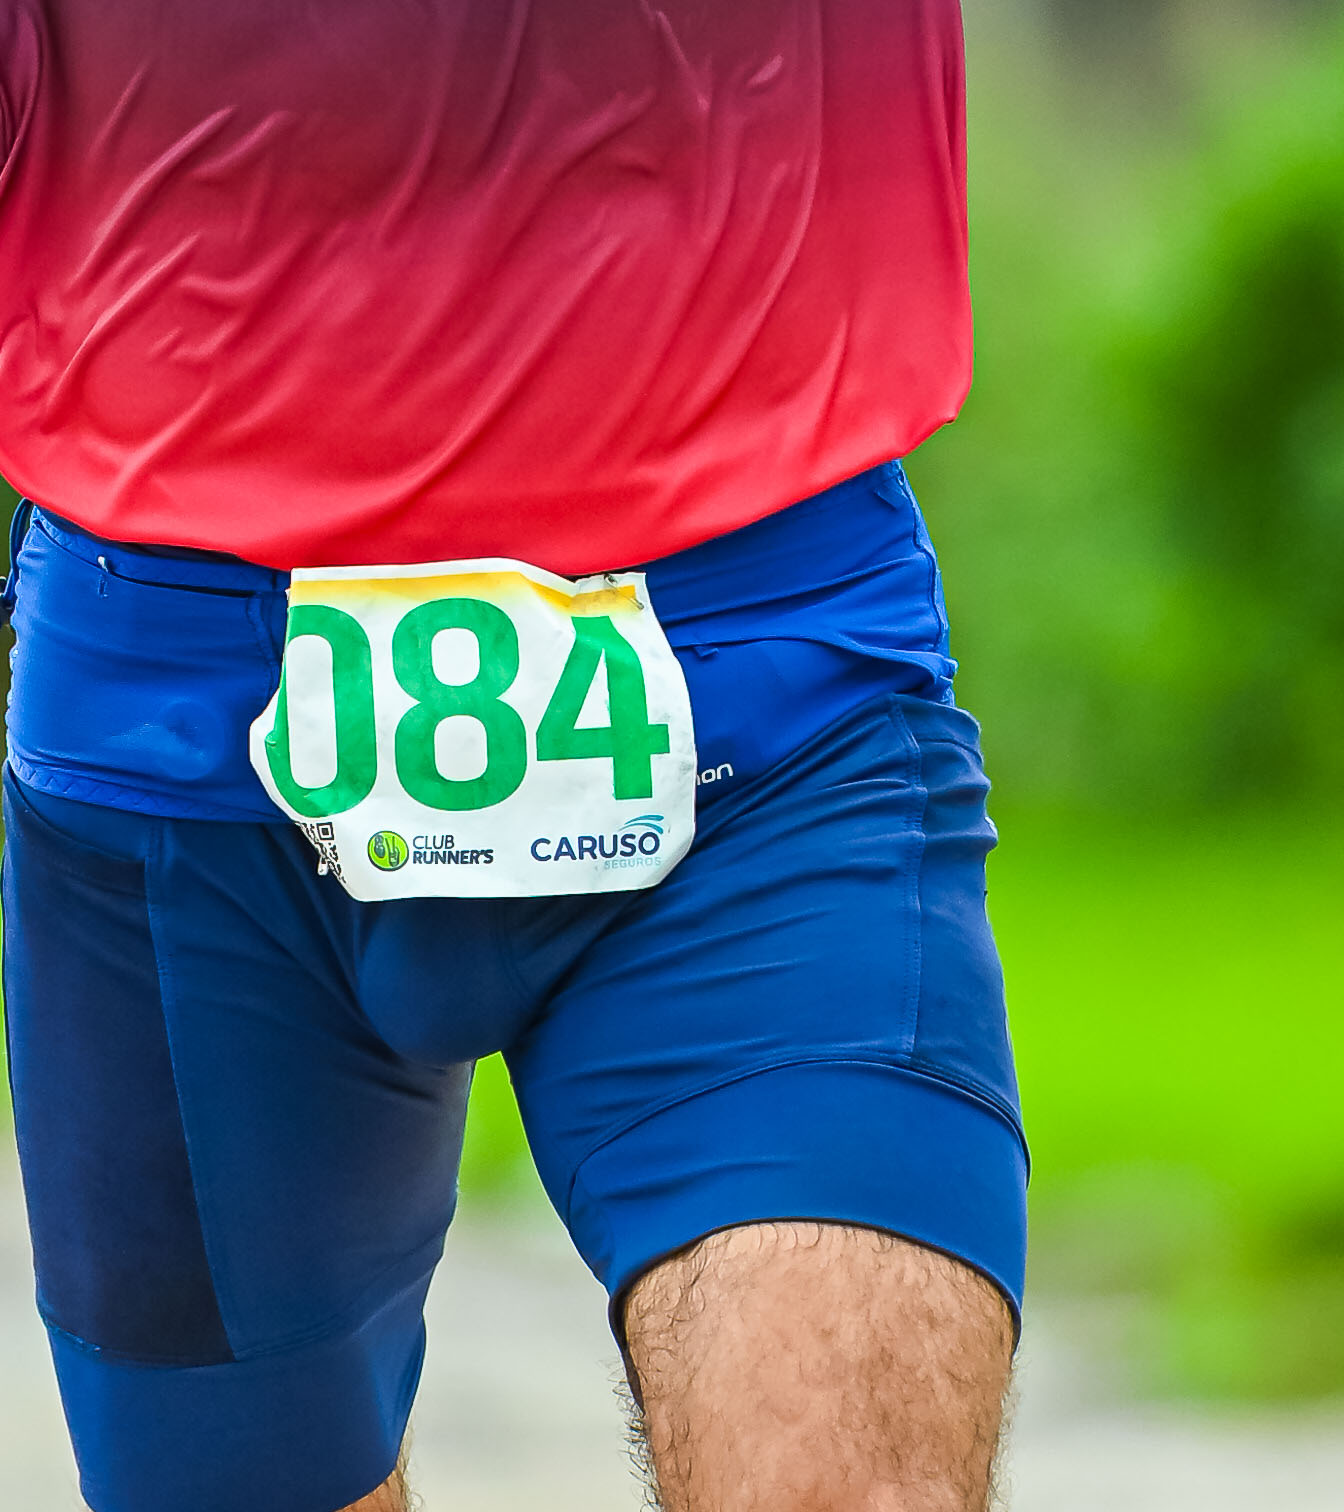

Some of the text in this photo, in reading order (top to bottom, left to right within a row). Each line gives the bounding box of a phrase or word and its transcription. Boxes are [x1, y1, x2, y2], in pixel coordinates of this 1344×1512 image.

[265, 596, 671, 818] 084
[412, 834, 455, 850] CLUB
[530, 831, 661, 862] CARUSO
[412, 849, 494, 865] RUNNER'S
[603, 856, 662, 871] SEGUROS
